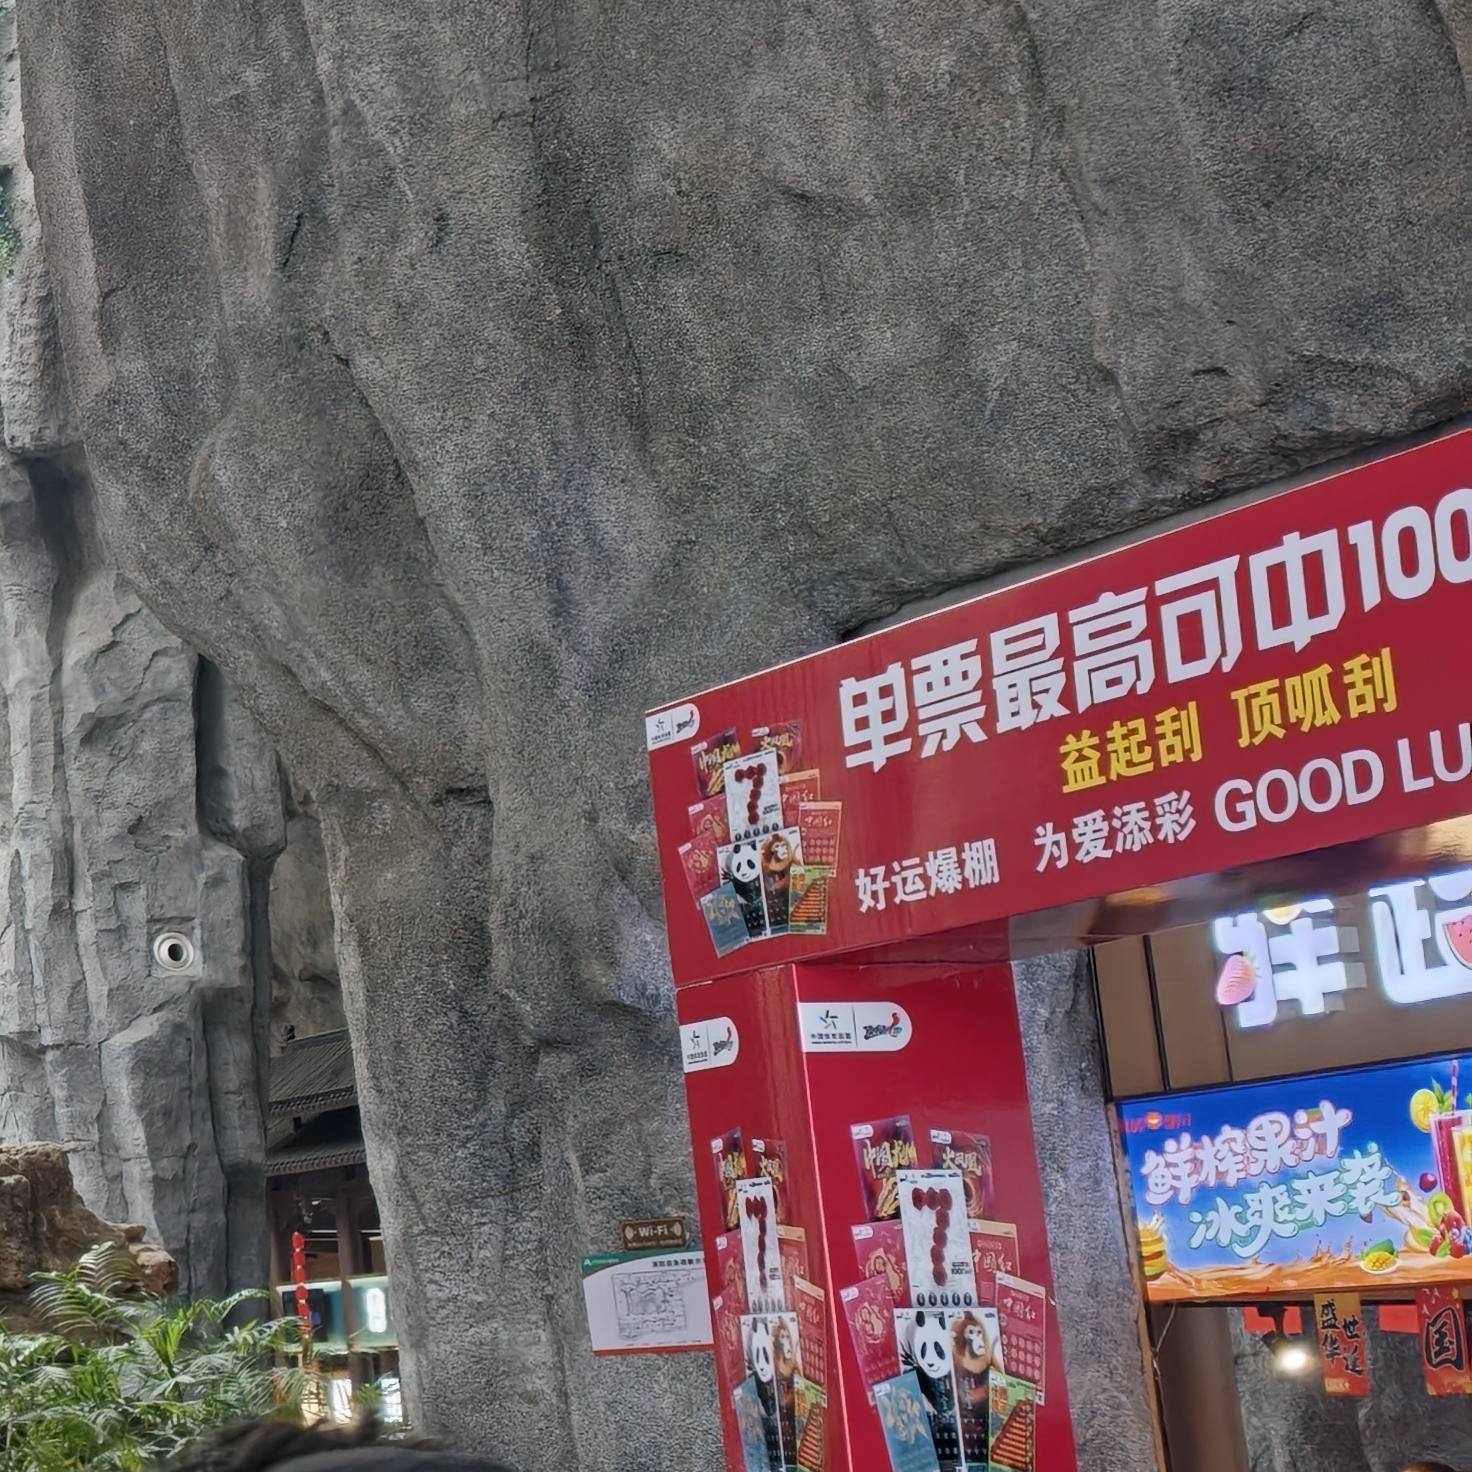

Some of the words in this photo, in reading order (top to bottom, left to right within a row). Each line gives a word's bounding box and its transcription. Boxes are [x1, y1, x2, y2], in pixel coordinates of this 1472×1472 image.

[1059, 708, 1202, 794] 益起刮
[1231, 647, 1397, 748] 顶呱刮
[856, 837, 1000, 912] 好运爆棚
[1034, 791, 1195, 872] 为爱添彩
[1214, 749, 1384, 833] GOOD
[1141, 1099, 1352, 1205] 鲜榨果汁
[1188, 1141, 1402, 1259] 冰爽来袭
[639, 1224, 668, 1237] Wi-Fi
[1424, 1307, 1466, 1371] 国
